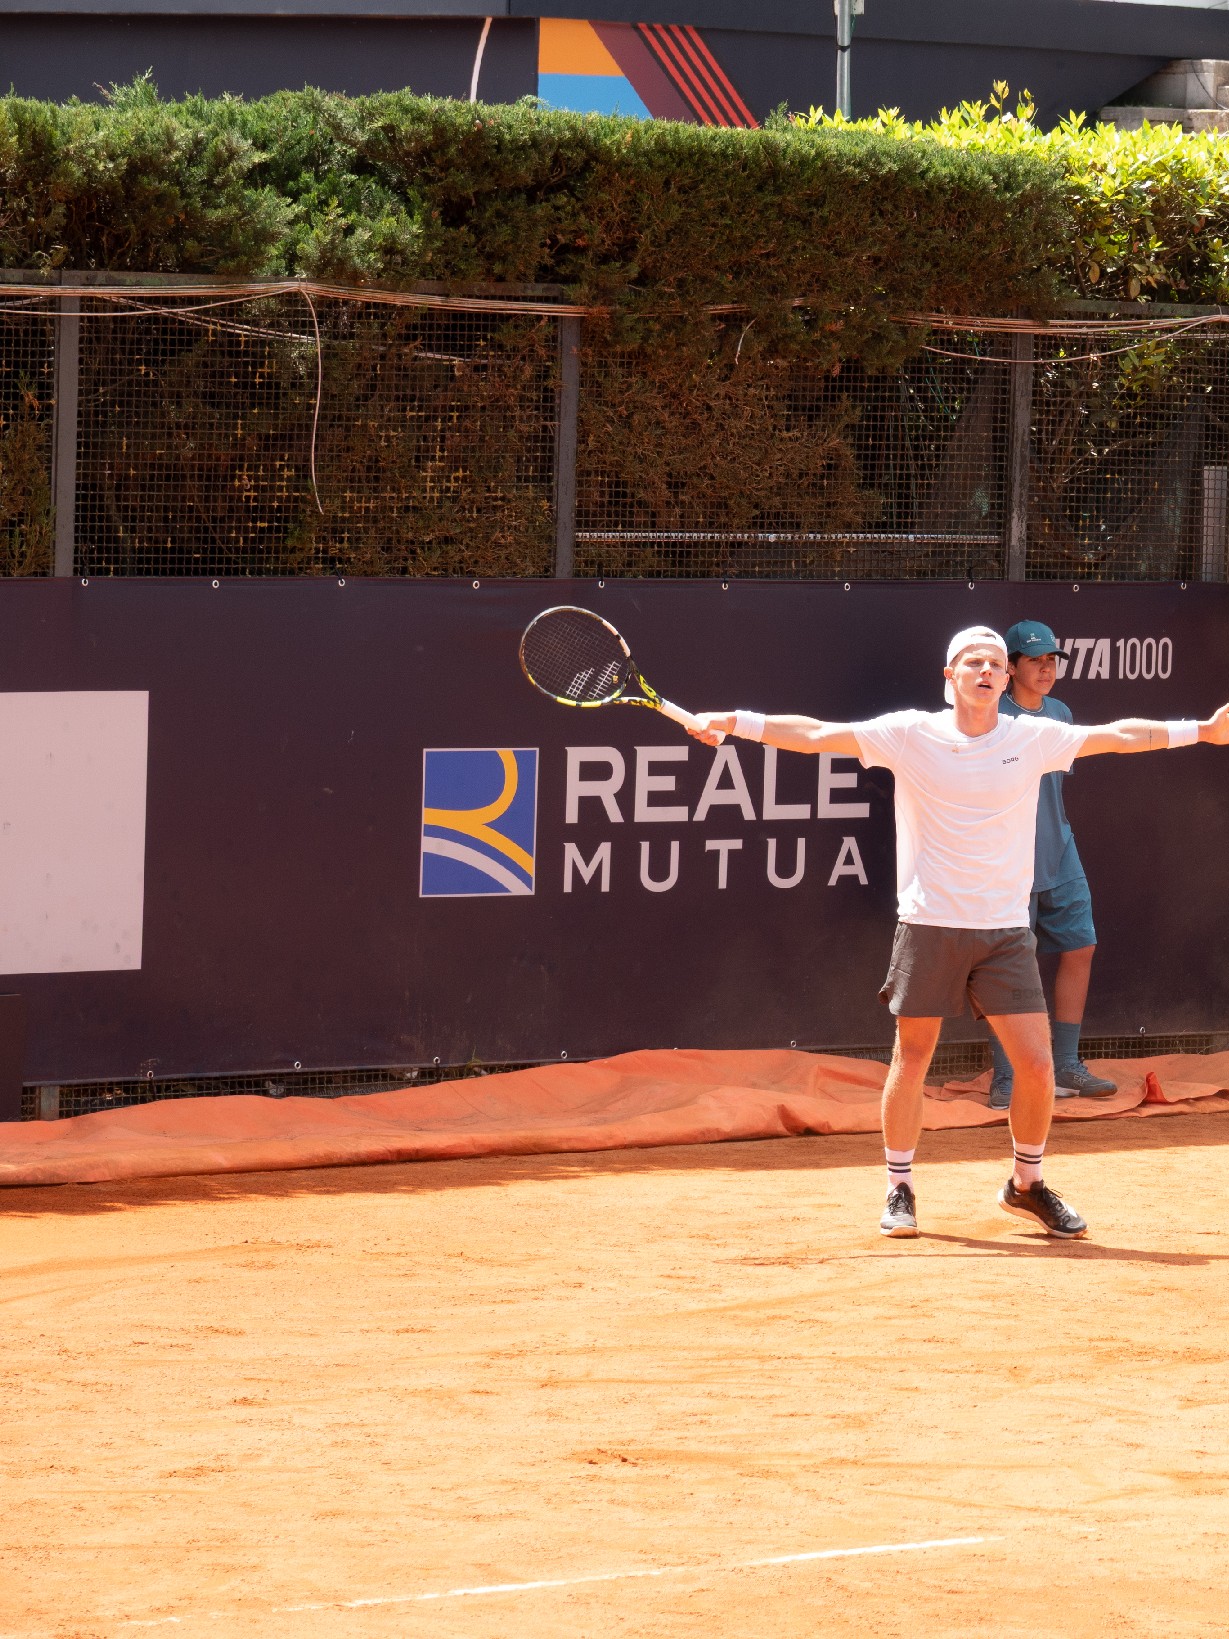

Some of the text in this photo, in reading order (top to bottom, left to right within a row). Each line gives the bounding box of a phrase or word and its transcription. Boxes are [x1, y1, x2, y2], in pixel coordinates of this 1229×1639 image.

[1116, 637, 1173, 679] 1000
[565, 744, 870, 824] REALE
[563, 836, 869, 893] MUTUA
